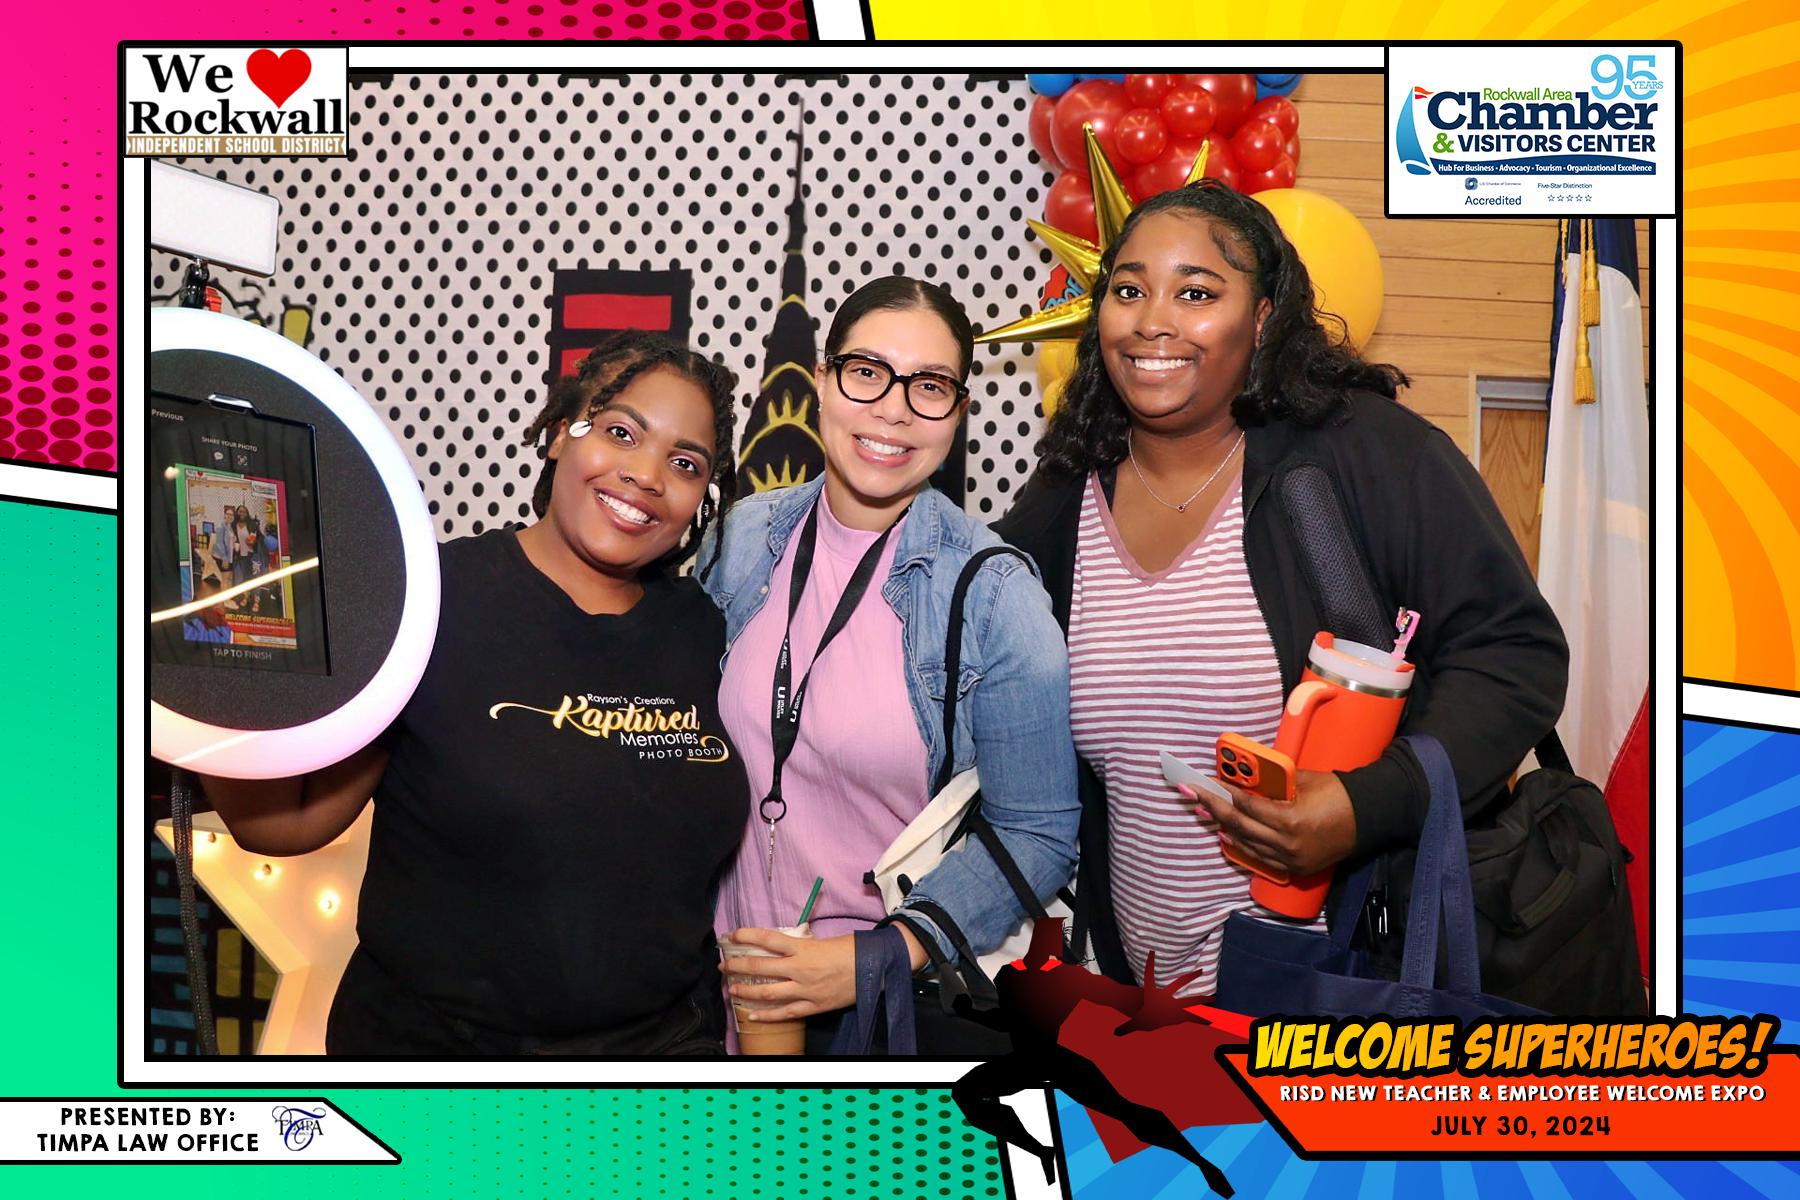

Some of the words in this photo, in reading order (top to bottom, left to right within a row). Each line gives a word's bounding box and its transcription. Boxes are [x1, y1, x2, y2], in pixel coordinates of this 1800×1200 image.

[151, 408, 185, 422] Previous
[201, 436, 221, 446] SHARE
[221, 440, 237, 449] YOUR
[237, 442, 258, 452] PHOTO
[213, 648, 229, 657] TAP
[230, 649, 243, 658] TO
[244, 650, 272, 662] FINISH
[586, 693, 628, 705] Rayson's
[634, 696, 676, 705] Creations
[552, 694, 700, 739] Kaptured
[620, 730, 699, 747] Memories
[639, 749, 683, 760] PHOTO
[688, 748, 723, 758] BOOTH
